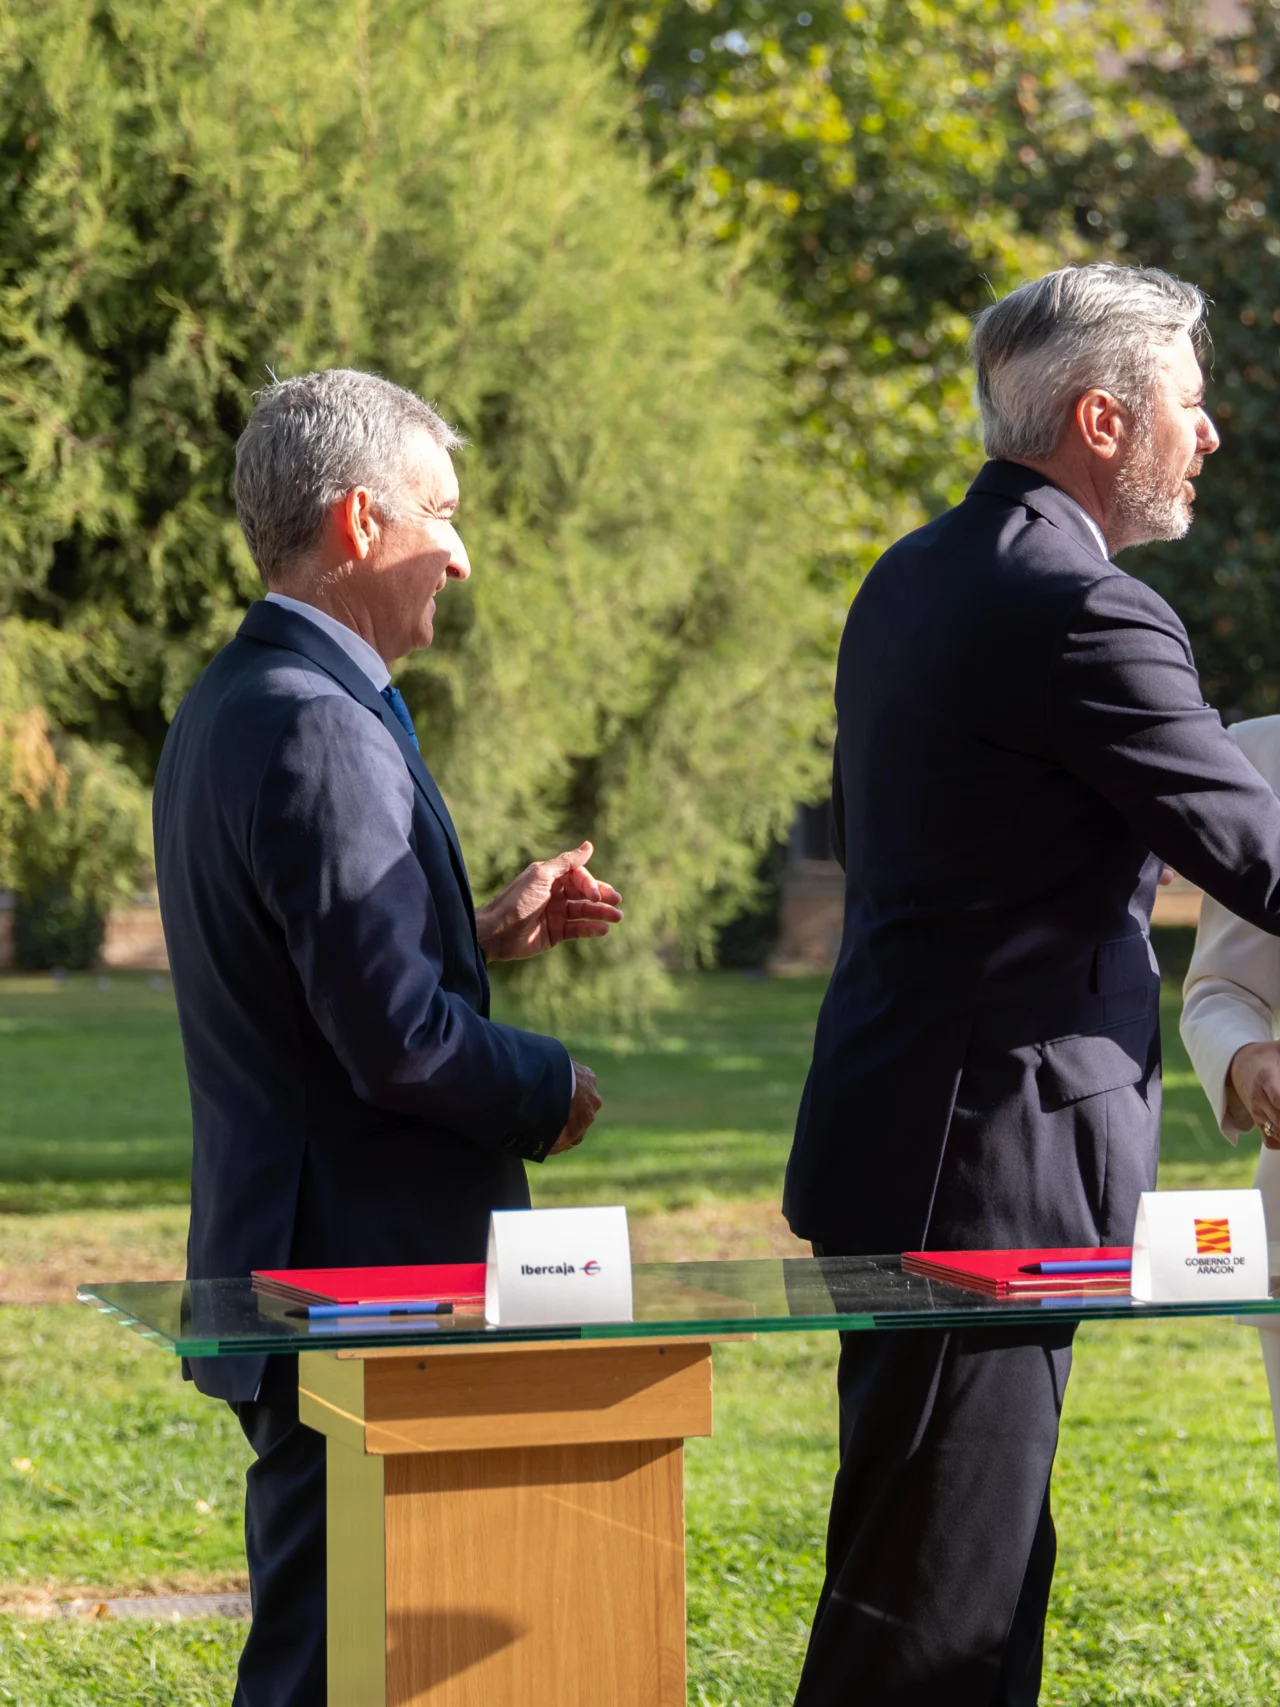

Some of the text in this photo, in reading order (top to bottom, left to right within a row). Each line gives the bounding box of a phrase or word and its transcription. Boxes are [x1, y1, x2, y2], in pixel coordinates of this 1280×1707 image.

[1185, 1256, 1246, 1266] GOBIERNO DE
[521, 1262, 576, 1276] Ibercaja
[1197, 1265, 1235, 1274] ARAGON
